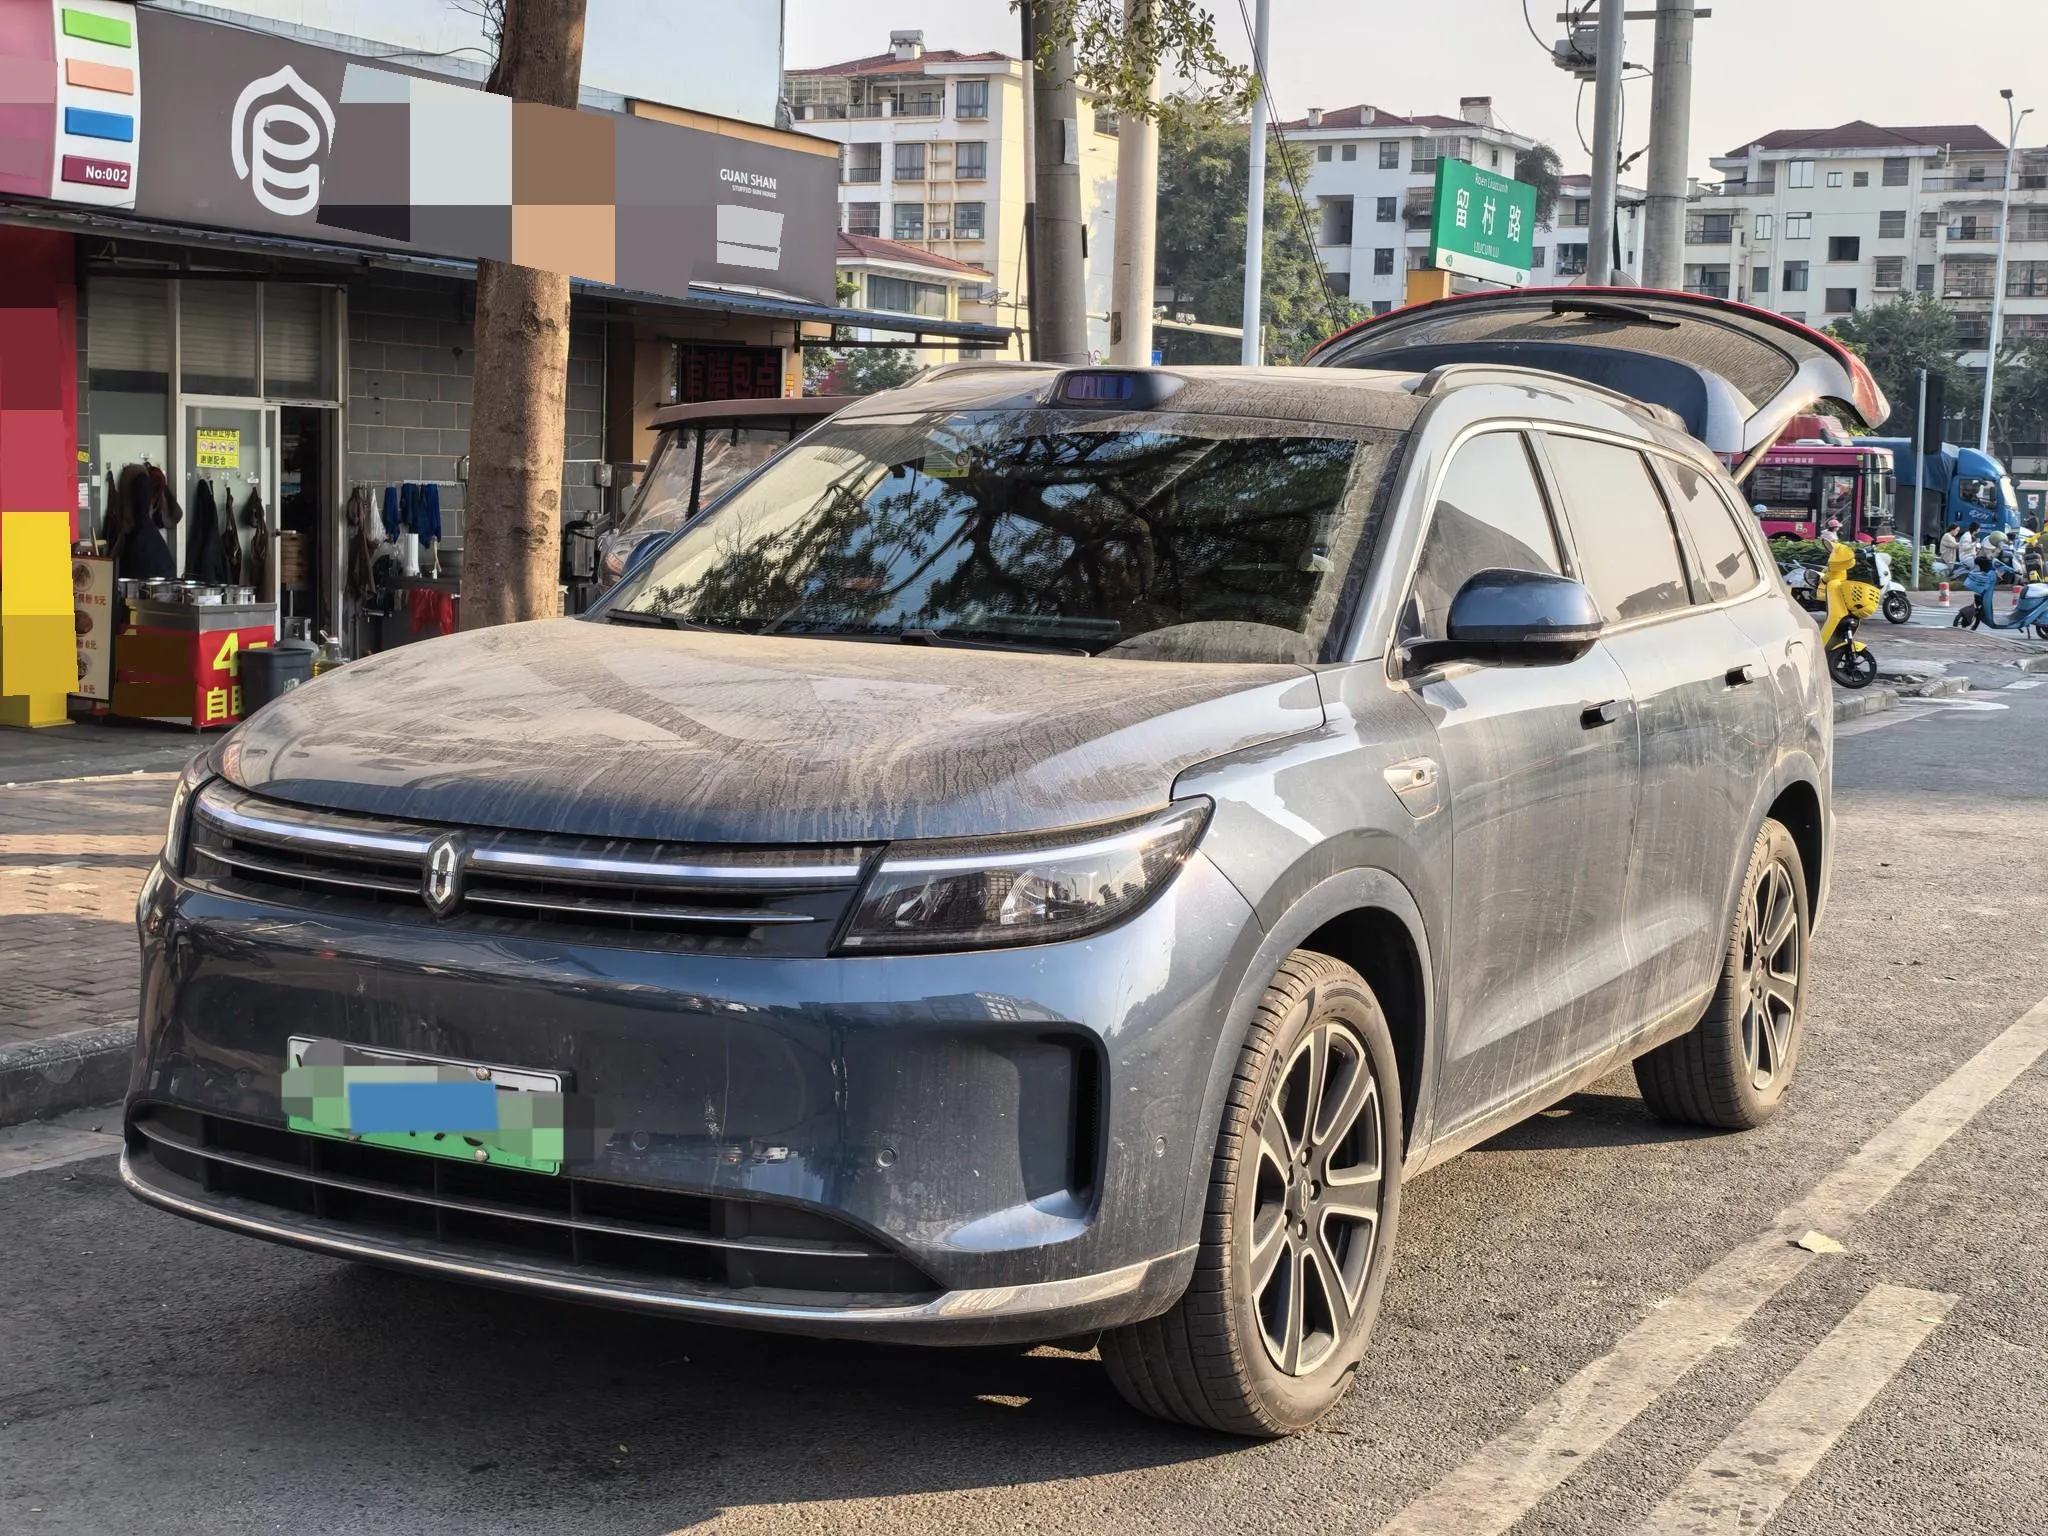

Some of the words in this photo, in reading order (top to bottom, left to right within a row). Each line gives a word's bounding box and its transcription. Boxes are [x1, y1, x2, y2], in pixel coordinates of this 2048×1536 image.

[86, 165, 128, 182] No:002
[720, 168, 748, 184] GUAN
[750, 174, 777, 190] SHAN
[1455, 187, 1522, 243] 留村路
